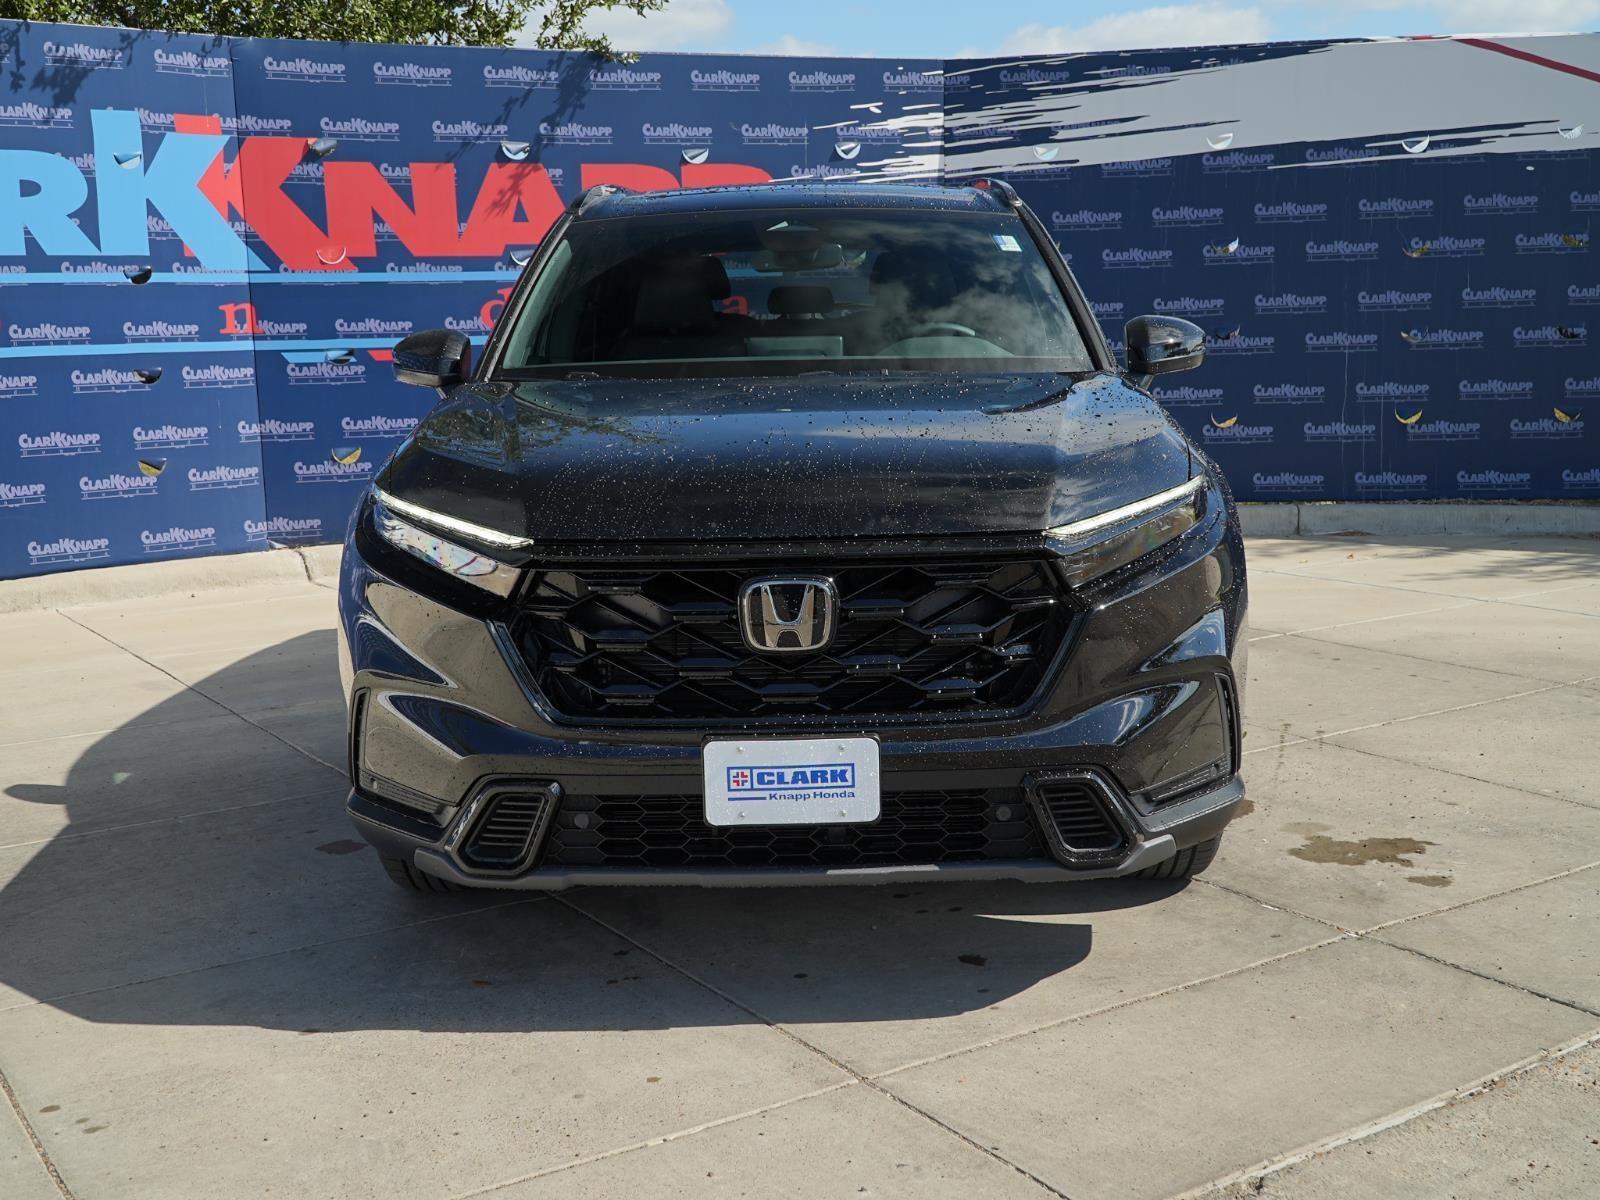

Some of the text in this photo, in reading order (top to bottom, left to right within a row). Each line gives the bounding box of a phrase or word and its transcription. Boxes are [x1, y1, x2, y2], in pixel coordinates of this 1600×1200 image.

[757, 769, 849, 786] CLARK
[769, 790, 855, 802] Knapp Honda
